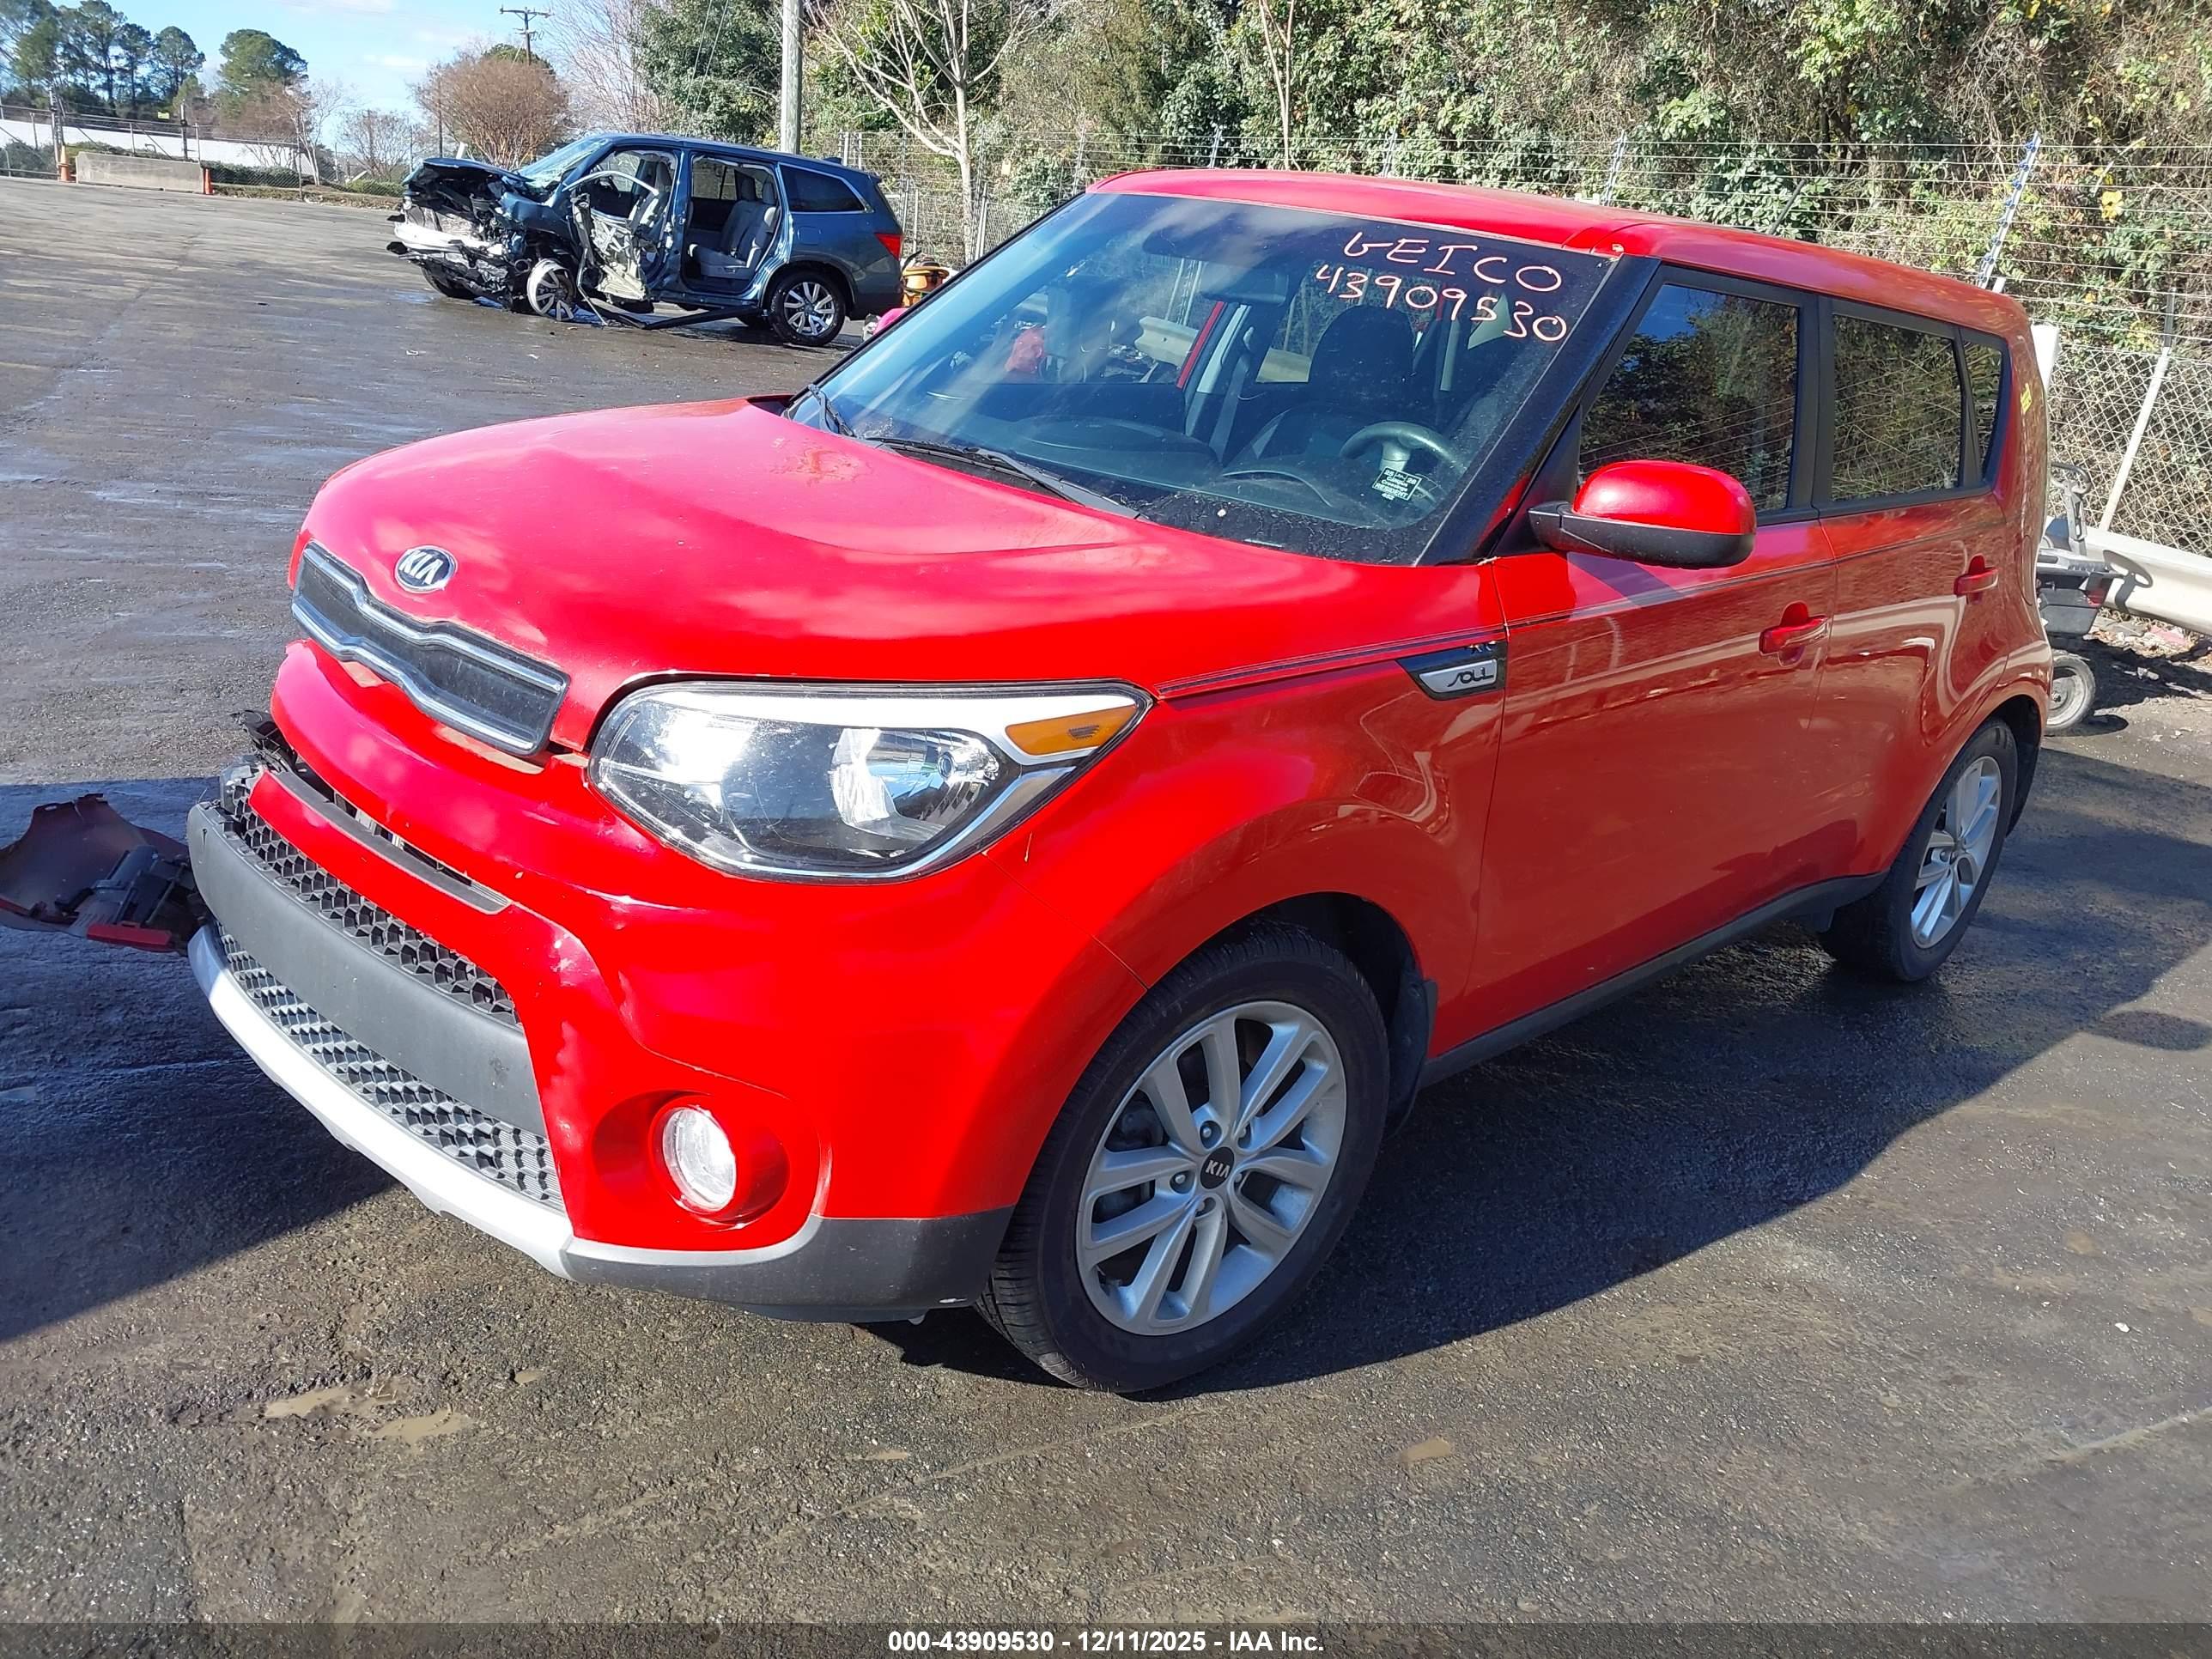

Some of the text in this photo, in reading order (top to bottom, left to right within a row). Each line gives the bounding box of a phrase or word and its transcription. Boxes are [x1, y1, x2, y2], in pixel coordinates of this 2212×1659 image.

[1342, 231, 1563, 292] GEICO
[1316, 263, 1568, 342] 43909530
[1375, 483, 1409, 498] RESIDENT
[398, 550, 444, 585] KIA
[1205, 1159, 1231, 1178] KIA
